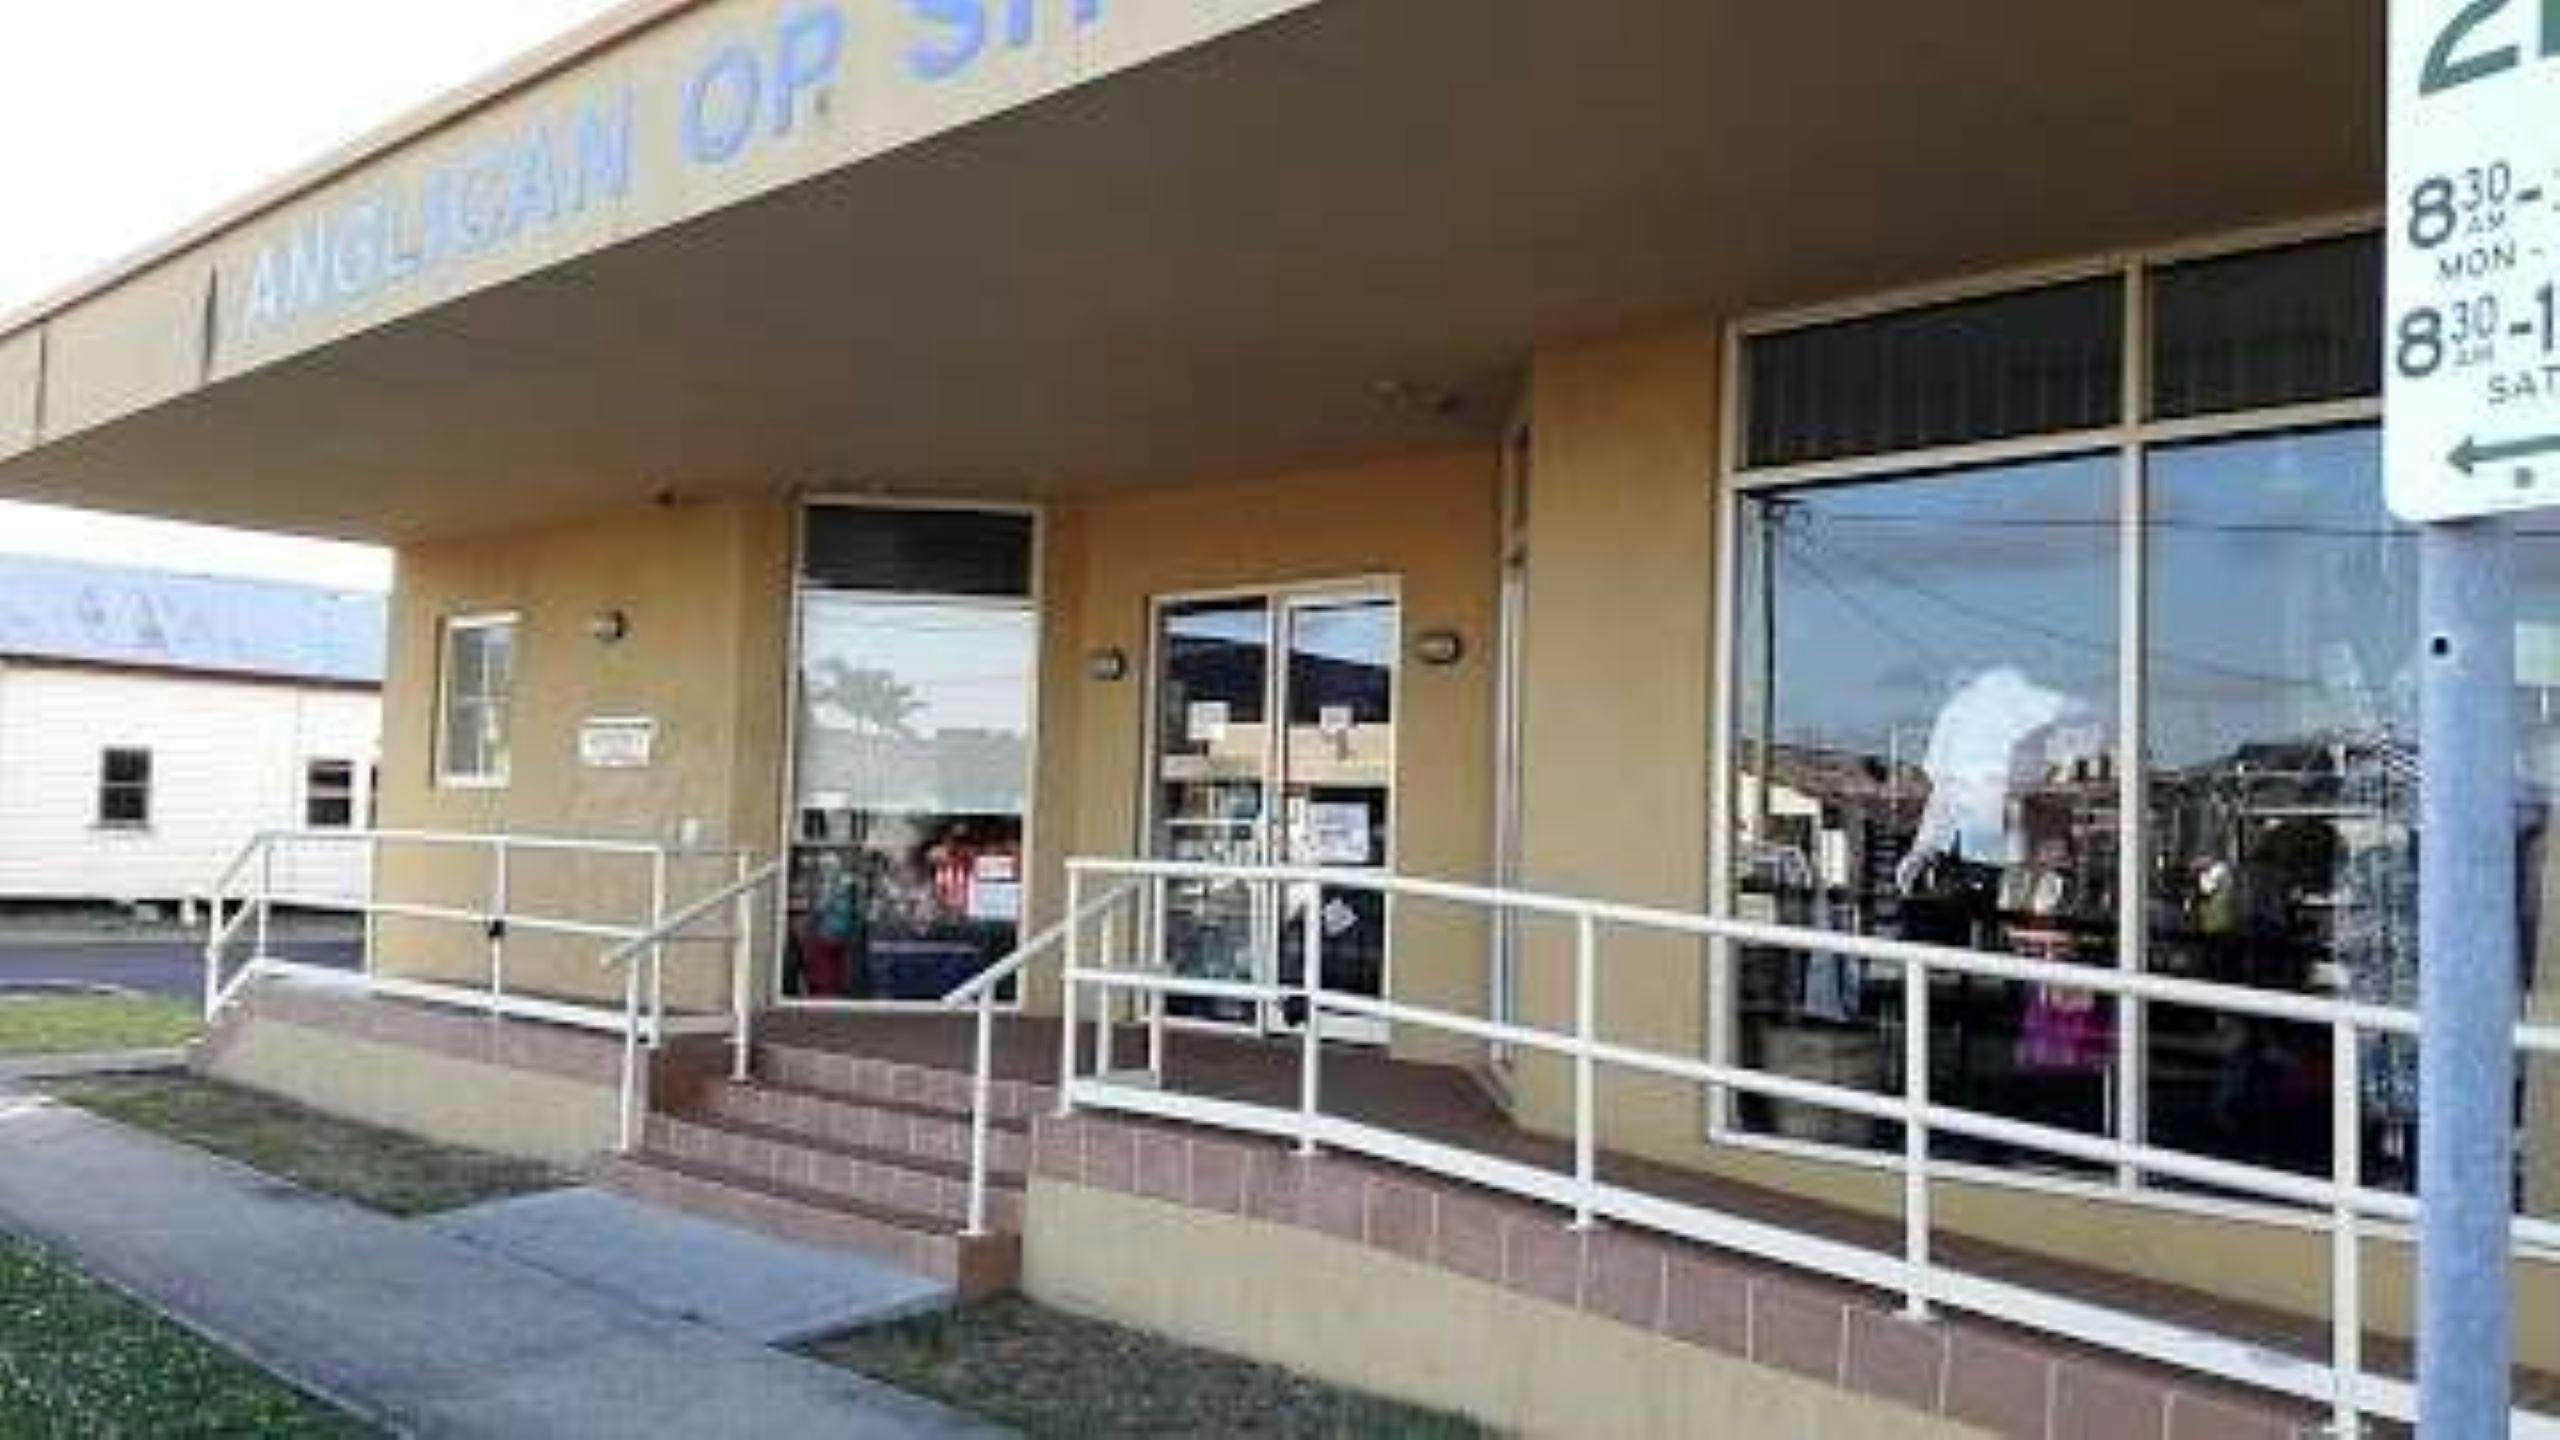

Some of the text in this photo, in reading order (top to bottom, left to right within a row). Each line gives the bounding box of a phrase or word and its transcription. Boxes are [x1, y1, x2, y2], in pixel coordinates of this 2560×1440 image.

[245, 82, 640, 322] ANGLICAN
[2438, 240, 2516, 278] MON
[2487, 366, 2560, 405] SAT
